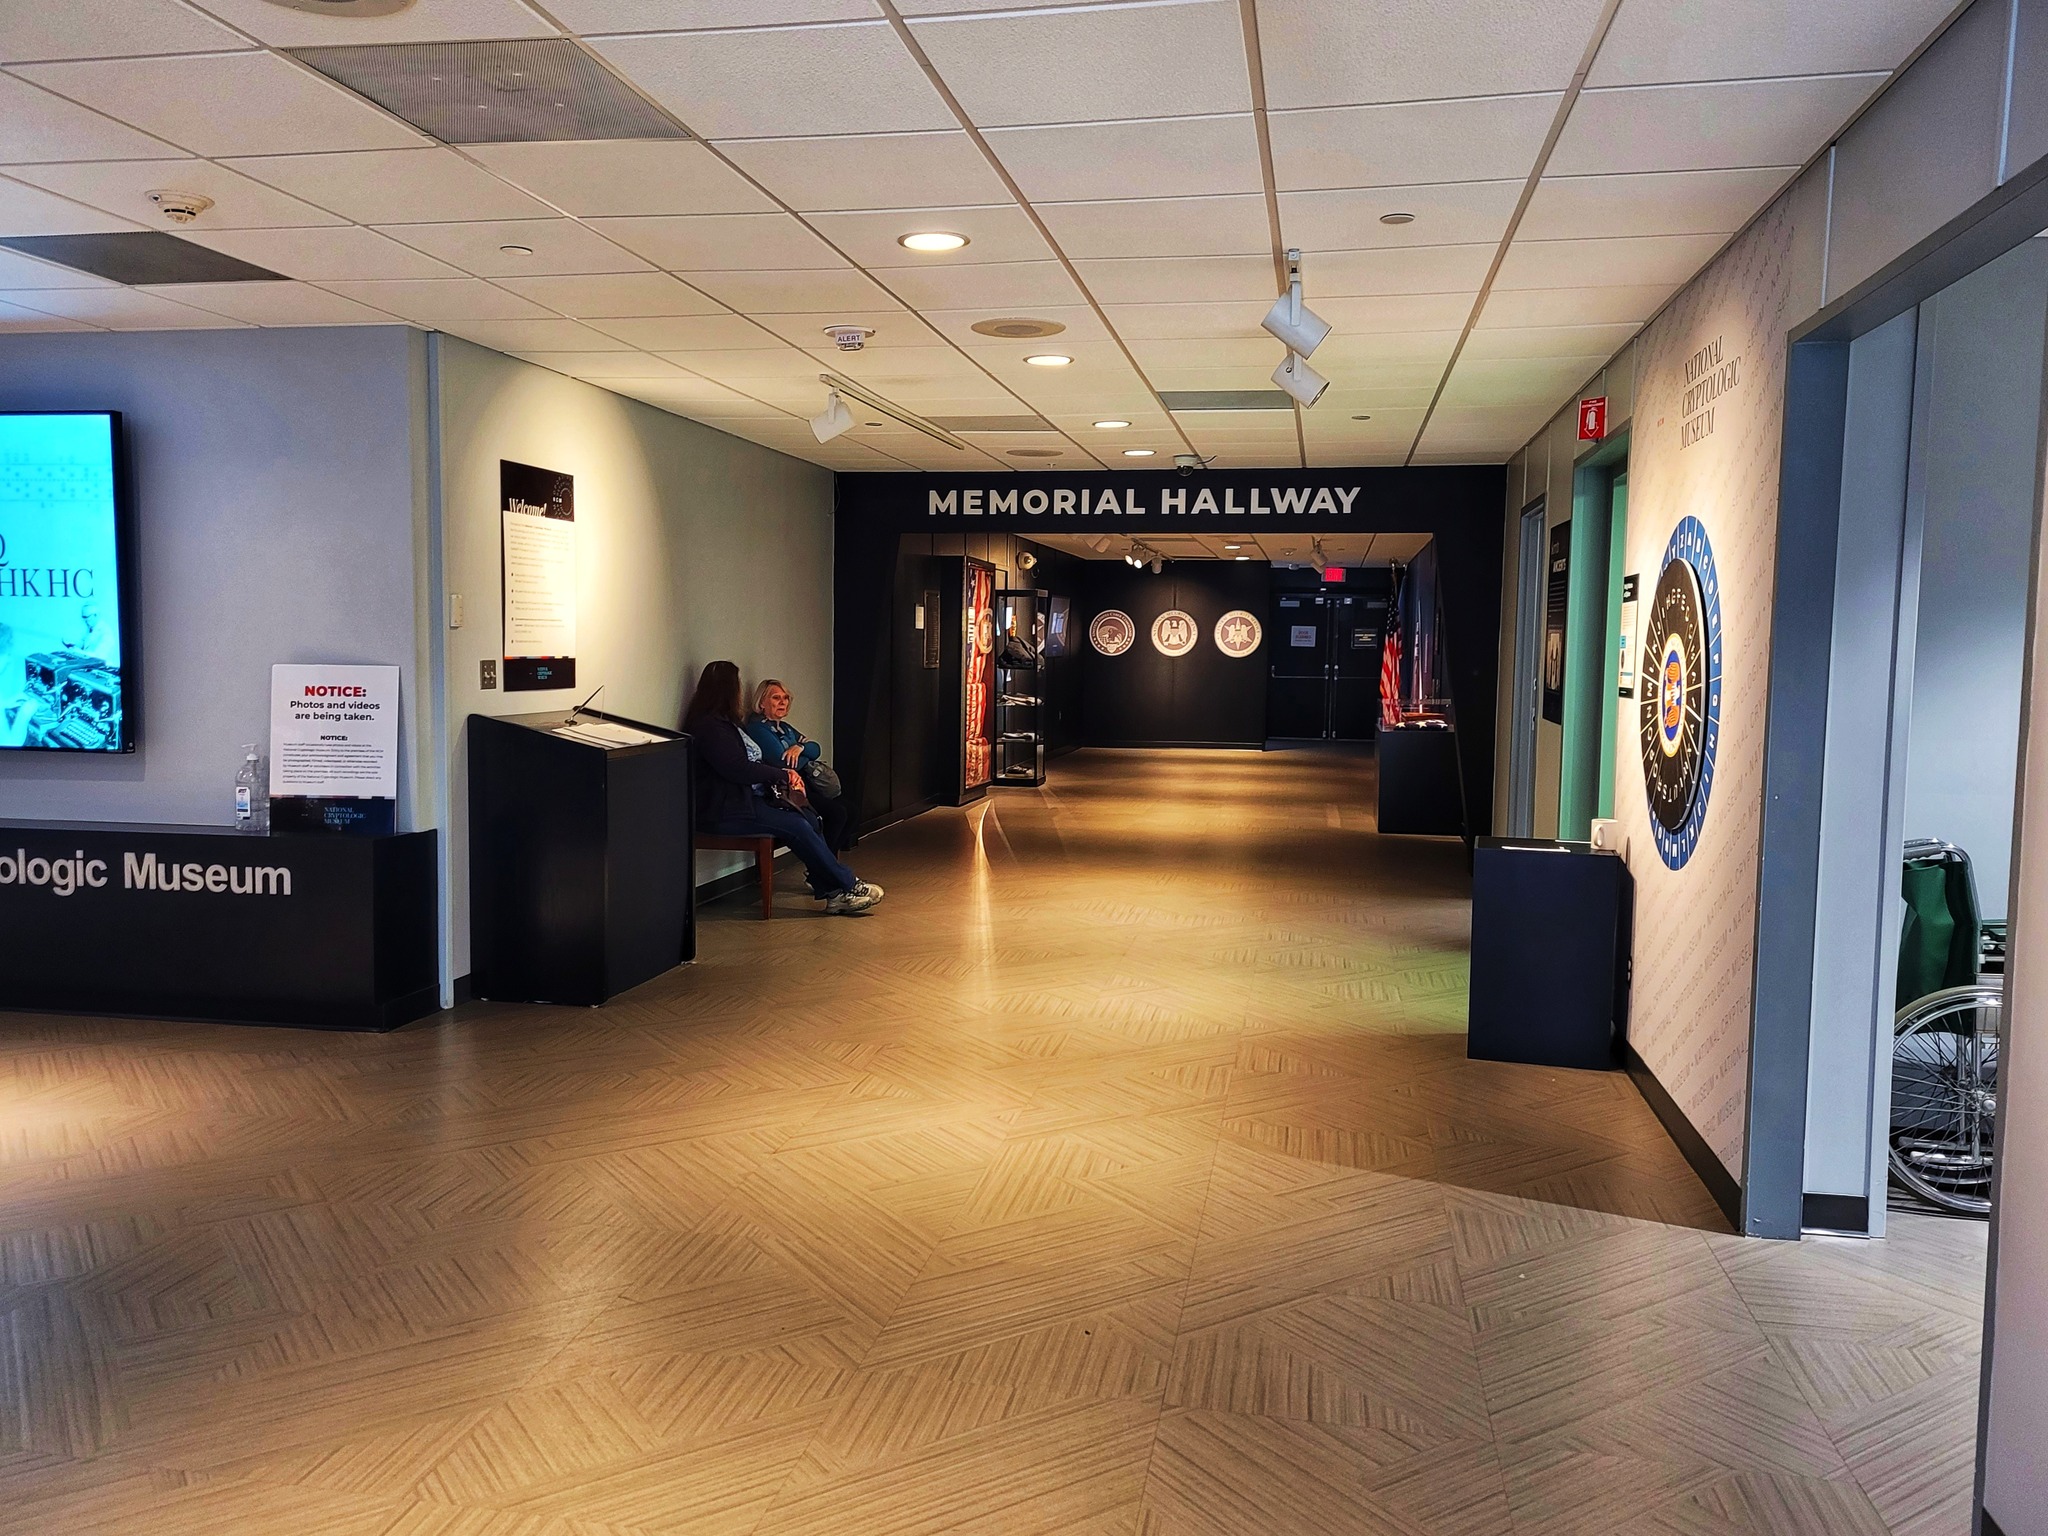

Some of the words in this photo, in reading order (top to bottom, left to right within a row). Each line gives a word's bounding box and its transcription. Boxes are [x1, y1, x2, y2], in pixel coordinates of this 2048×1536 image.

[1684, 335, 1723, 387] NATIONAL
[1682, 356, 1741, 418] CRYPTOLOGIC
[1680, 406, 1715, 450] MUSEUM
[928, 489, 1146, 516] MEMORIAL
[1161, 486, 1362, 515] HALLWAY
[290, 701, 325, 709] Photos
[327, 701, 346, 709] and
[348, 701, 380, 710] videos
[305, 686, 367, 697] NOTICE:
[313, 712, 341, 722] being
[344, 713, 375, 721] taken.
[0, 848, 108, 896] ologic
[124, 852, 292, 896] Museum
